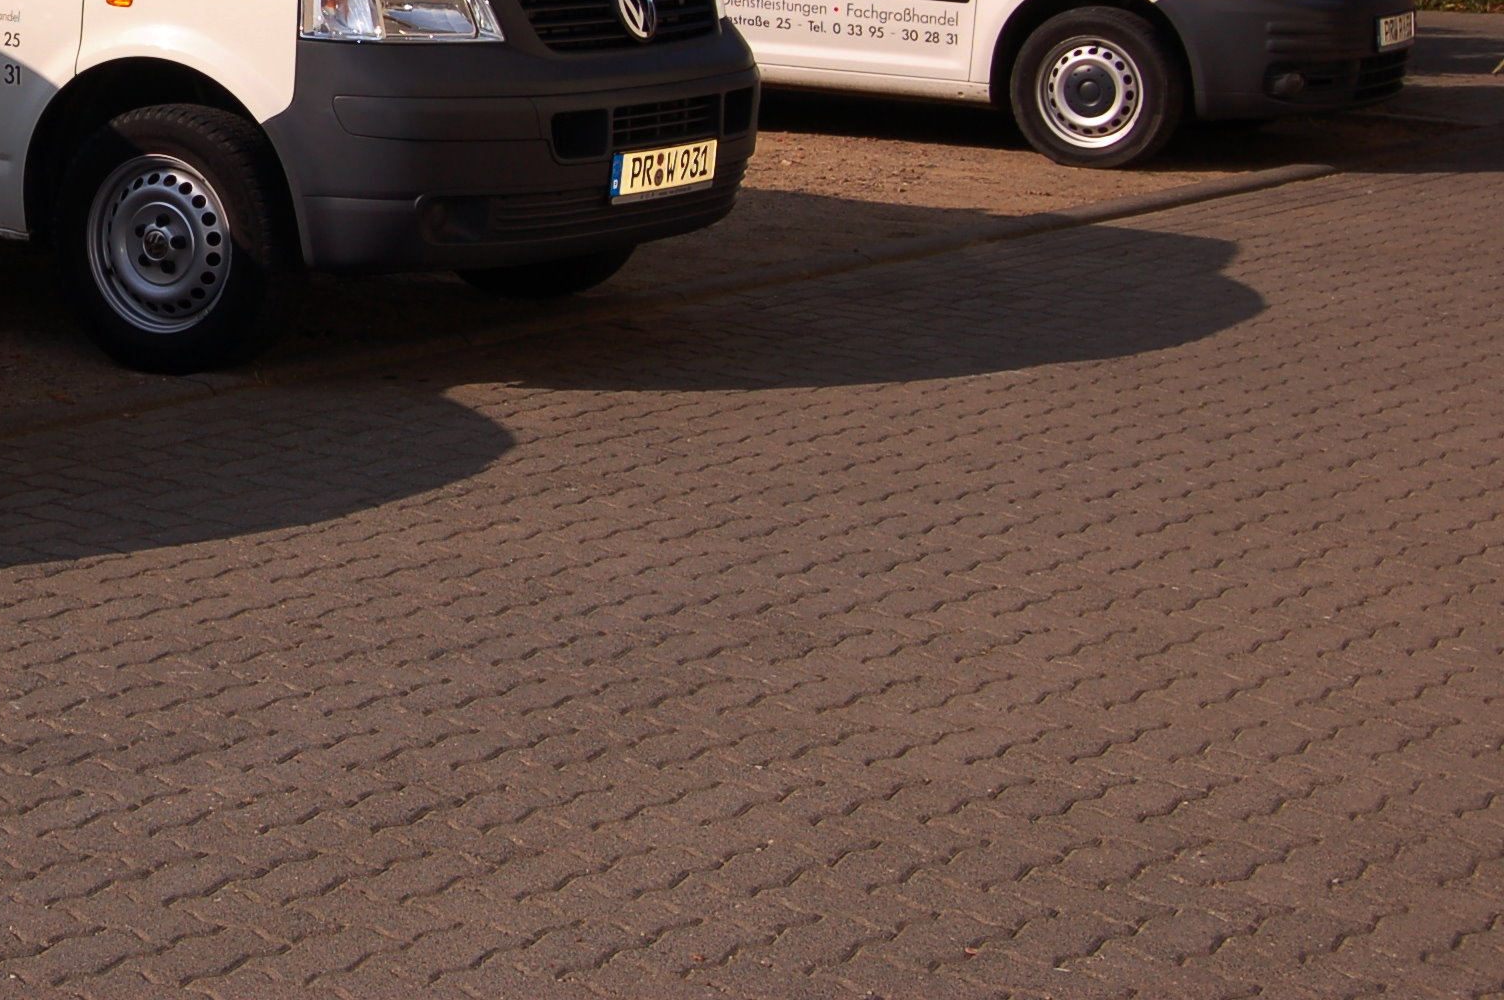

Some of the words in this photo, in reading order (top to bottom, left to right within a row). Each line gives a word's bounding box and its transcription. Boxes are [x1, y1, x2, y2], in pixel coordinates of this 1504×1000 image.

[846, 2, 959, 27] Fachgroßhandel
[4, 31, 21, 48] 25
[730, 15, 770, 28] straße
[776, 17, 792, 30] 25
[808, 20, 827, 34] Tel.
[832, 24, 842, 36] 0
[847, 24, 863, 37] 33
[869, 26, 884, 39] 95
[902, 28, 919, 42] 30
[924, 31, 940, 44] 28
[946, 32, 959, 46] 31
[4, 64, 21, 86] 31
[630, 154, 654, 189] PR
[680, 144, 708, 181] 931
